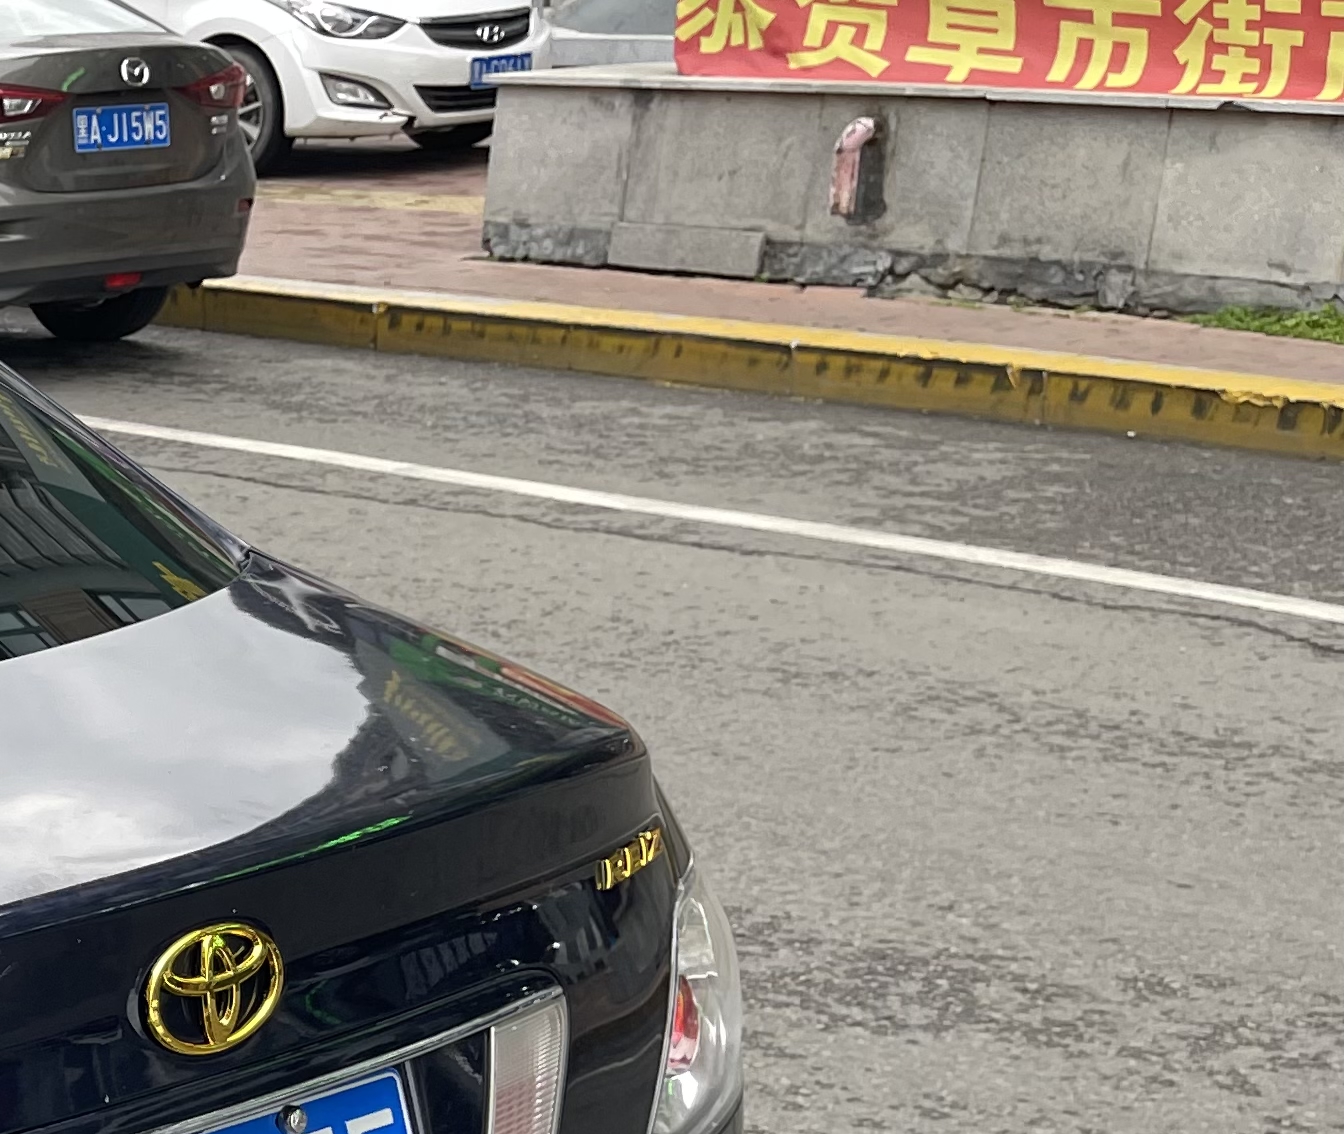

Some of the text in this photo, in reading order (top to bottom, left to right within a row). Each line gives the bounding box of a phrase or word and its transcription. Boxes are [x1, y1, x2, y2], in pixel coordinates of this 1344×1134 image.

[675, 0, 1344, 101] 恭贺早市街
